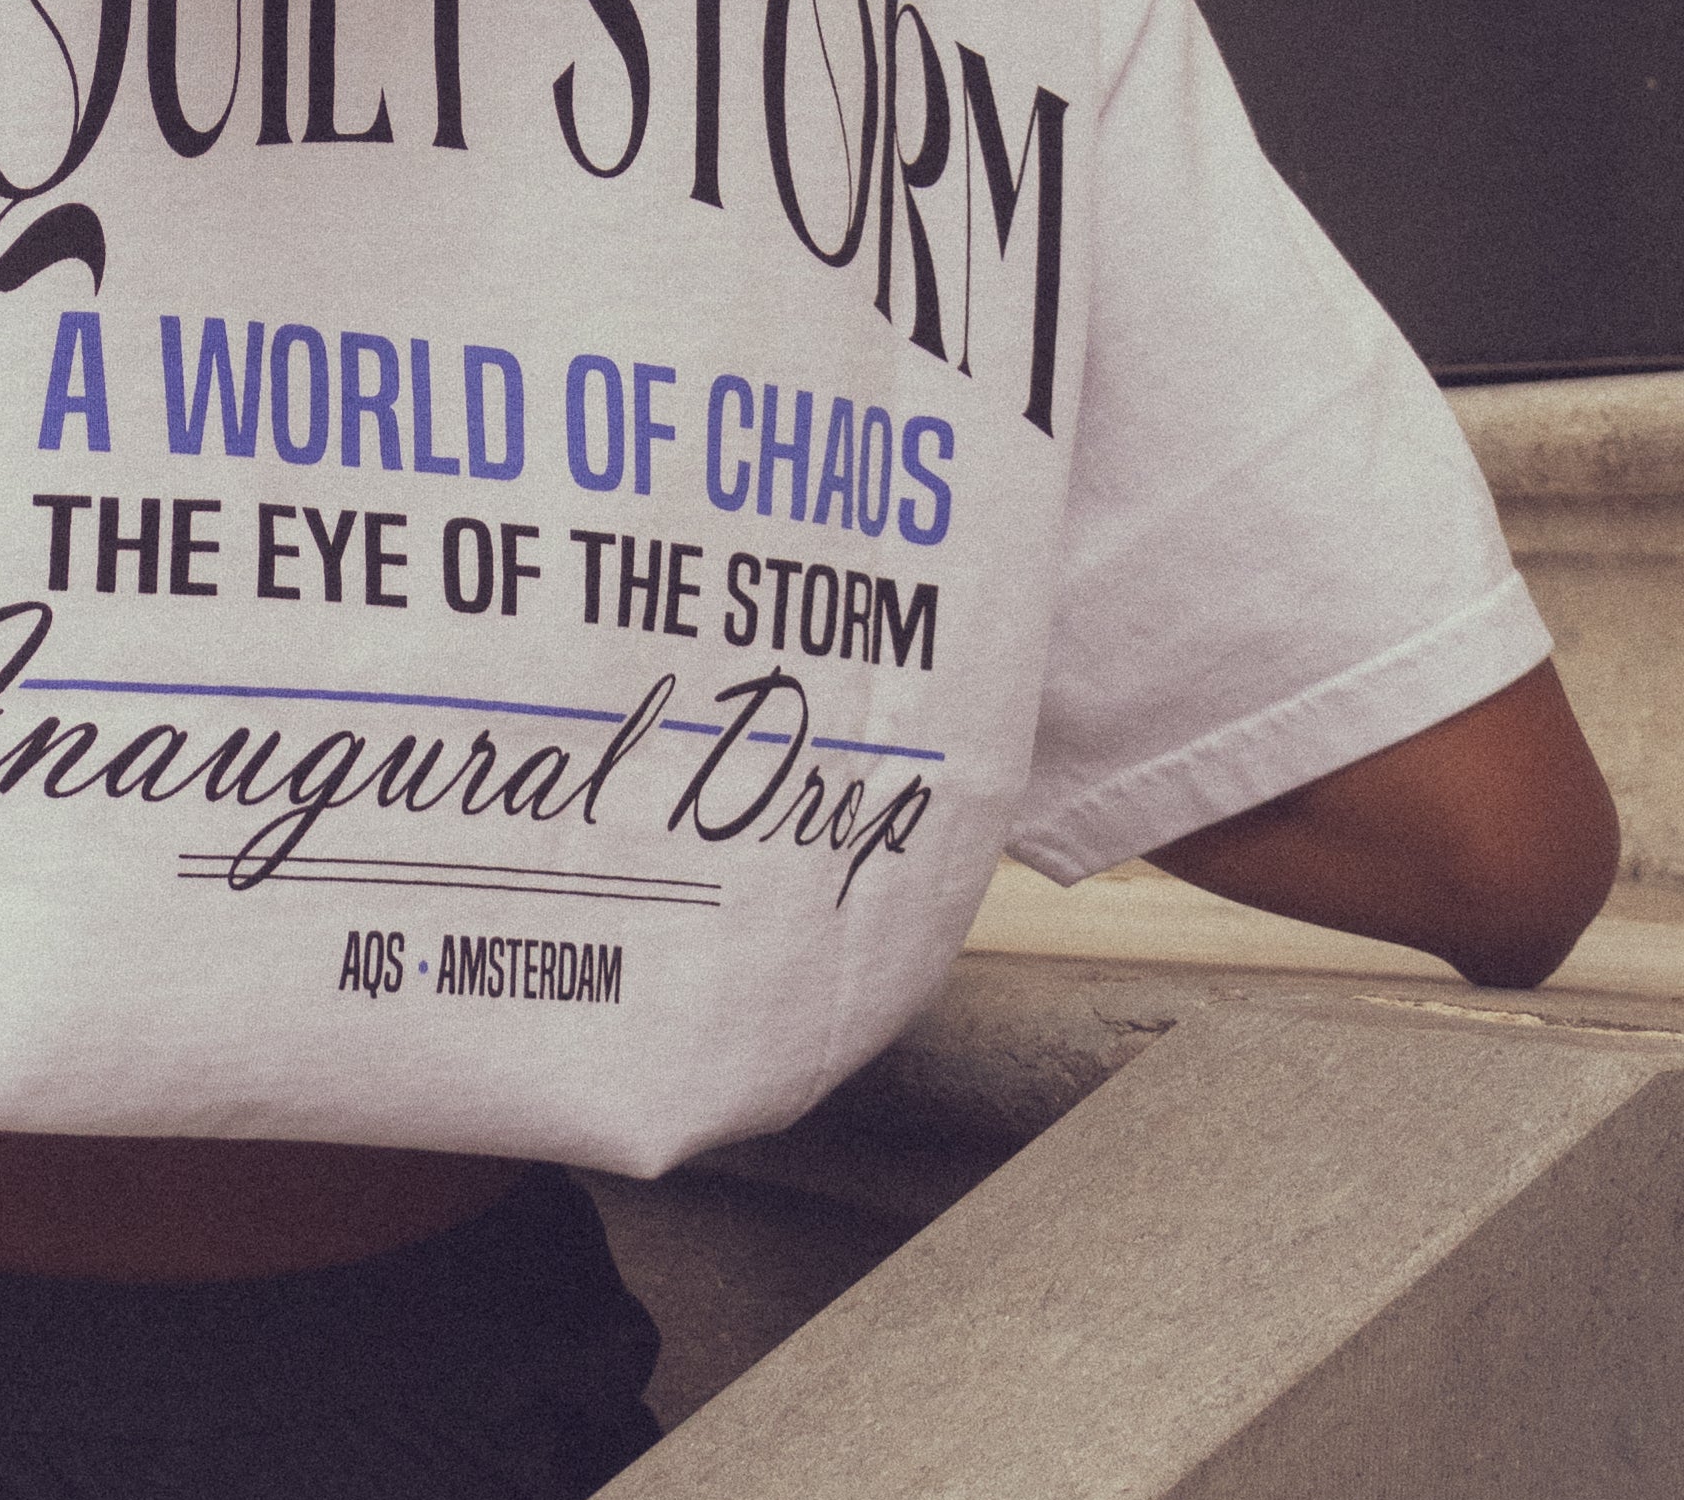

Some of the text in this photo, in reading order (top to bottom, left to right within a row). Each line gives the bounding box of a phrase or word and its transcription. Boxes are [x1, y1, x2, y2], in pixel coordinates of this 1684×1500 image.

[36, 310, 111, 453] A
[160, 314, 525, 481] WORLD
[565, 353, 678, 496] OF
[705, 374, 955, 546] CHAOS
[32, 494, 222, 597] THE
[256, 502, 408, 609] EYE
[442, 517, 541, 617] OF
[570, 529, 704, 639] THE
[723, 551, 939, 671] STORM
[668, 665, 933, 909] Drop
[338, 930, 623, 1004] AQS AMSTERDAM
